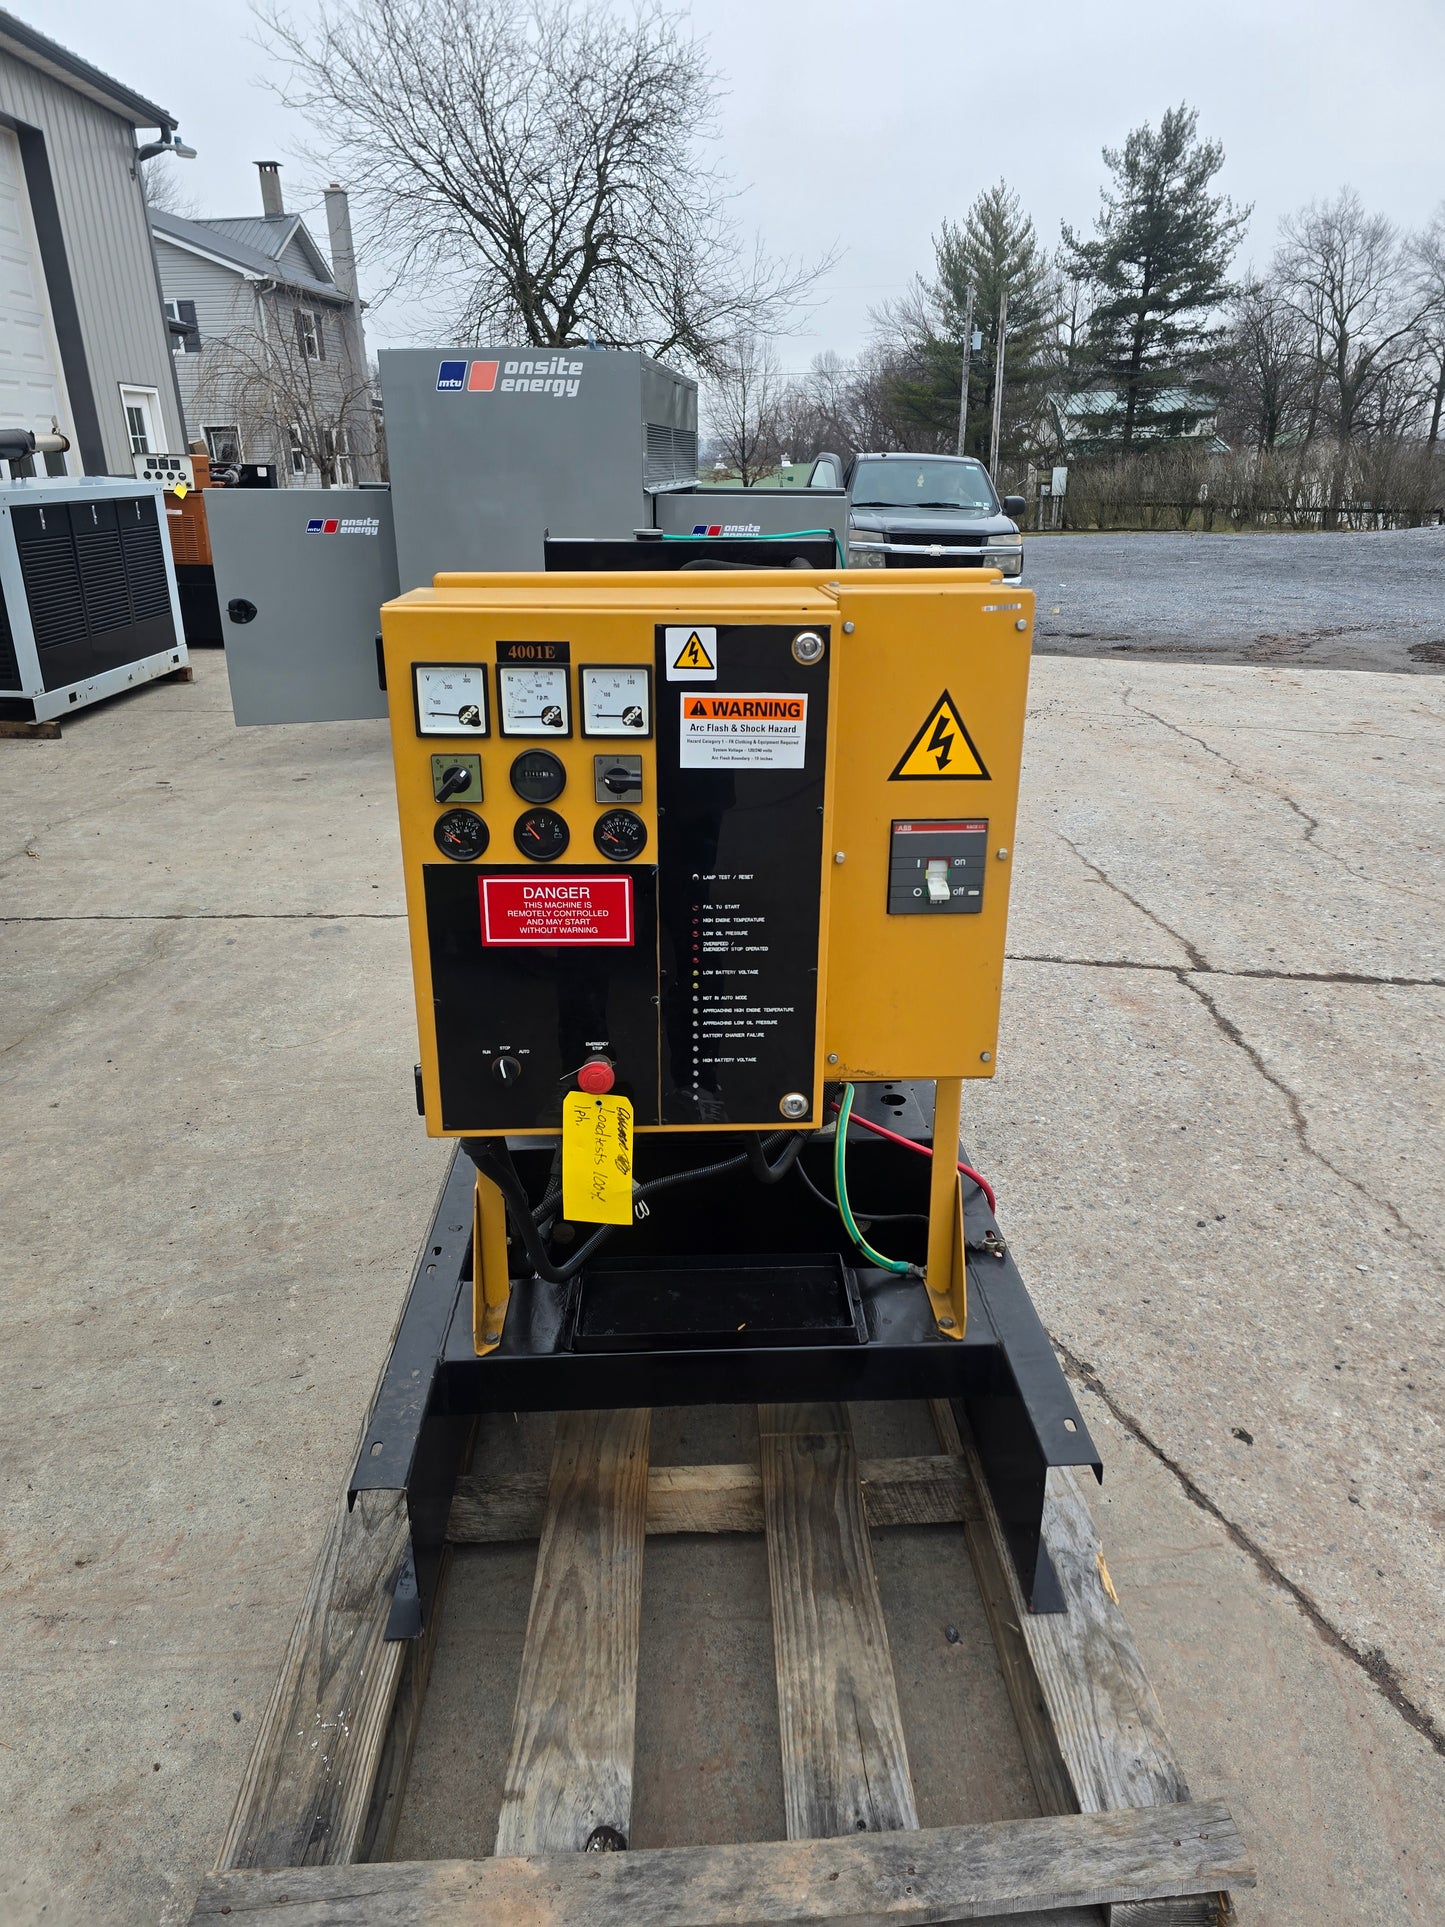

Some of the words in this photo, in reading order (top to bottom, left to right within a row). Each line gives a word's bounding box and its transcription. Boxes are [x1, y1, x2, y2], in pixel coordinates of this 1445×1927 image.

[504, 357, 583, 375] onsite
[438, 379, 462, 387] mtu
[500, 378, 580, 397] energy
[341, 517, 379, 526] onsite
[340, 526, 378, 535] energy
[724, 523, 760, 532] onsite
[508, 645, 556, 659] 4001E
[712, 701, 800, 718] WARNING
[690, 723, 705, 732] Arc
[706, 723, 729, 732] Flash
[731, 724, 738, 732] &
[740, 724, 766, 733] Shock
[768, 724, 797, 733] Hazard
[954, 858, 966, 866] on
[523, 887, 591, 899] DANGER
[952, 886, 965, 896] off
[526, 918, 544, 926] AND
[559, 926, 598, 934] WARNING
